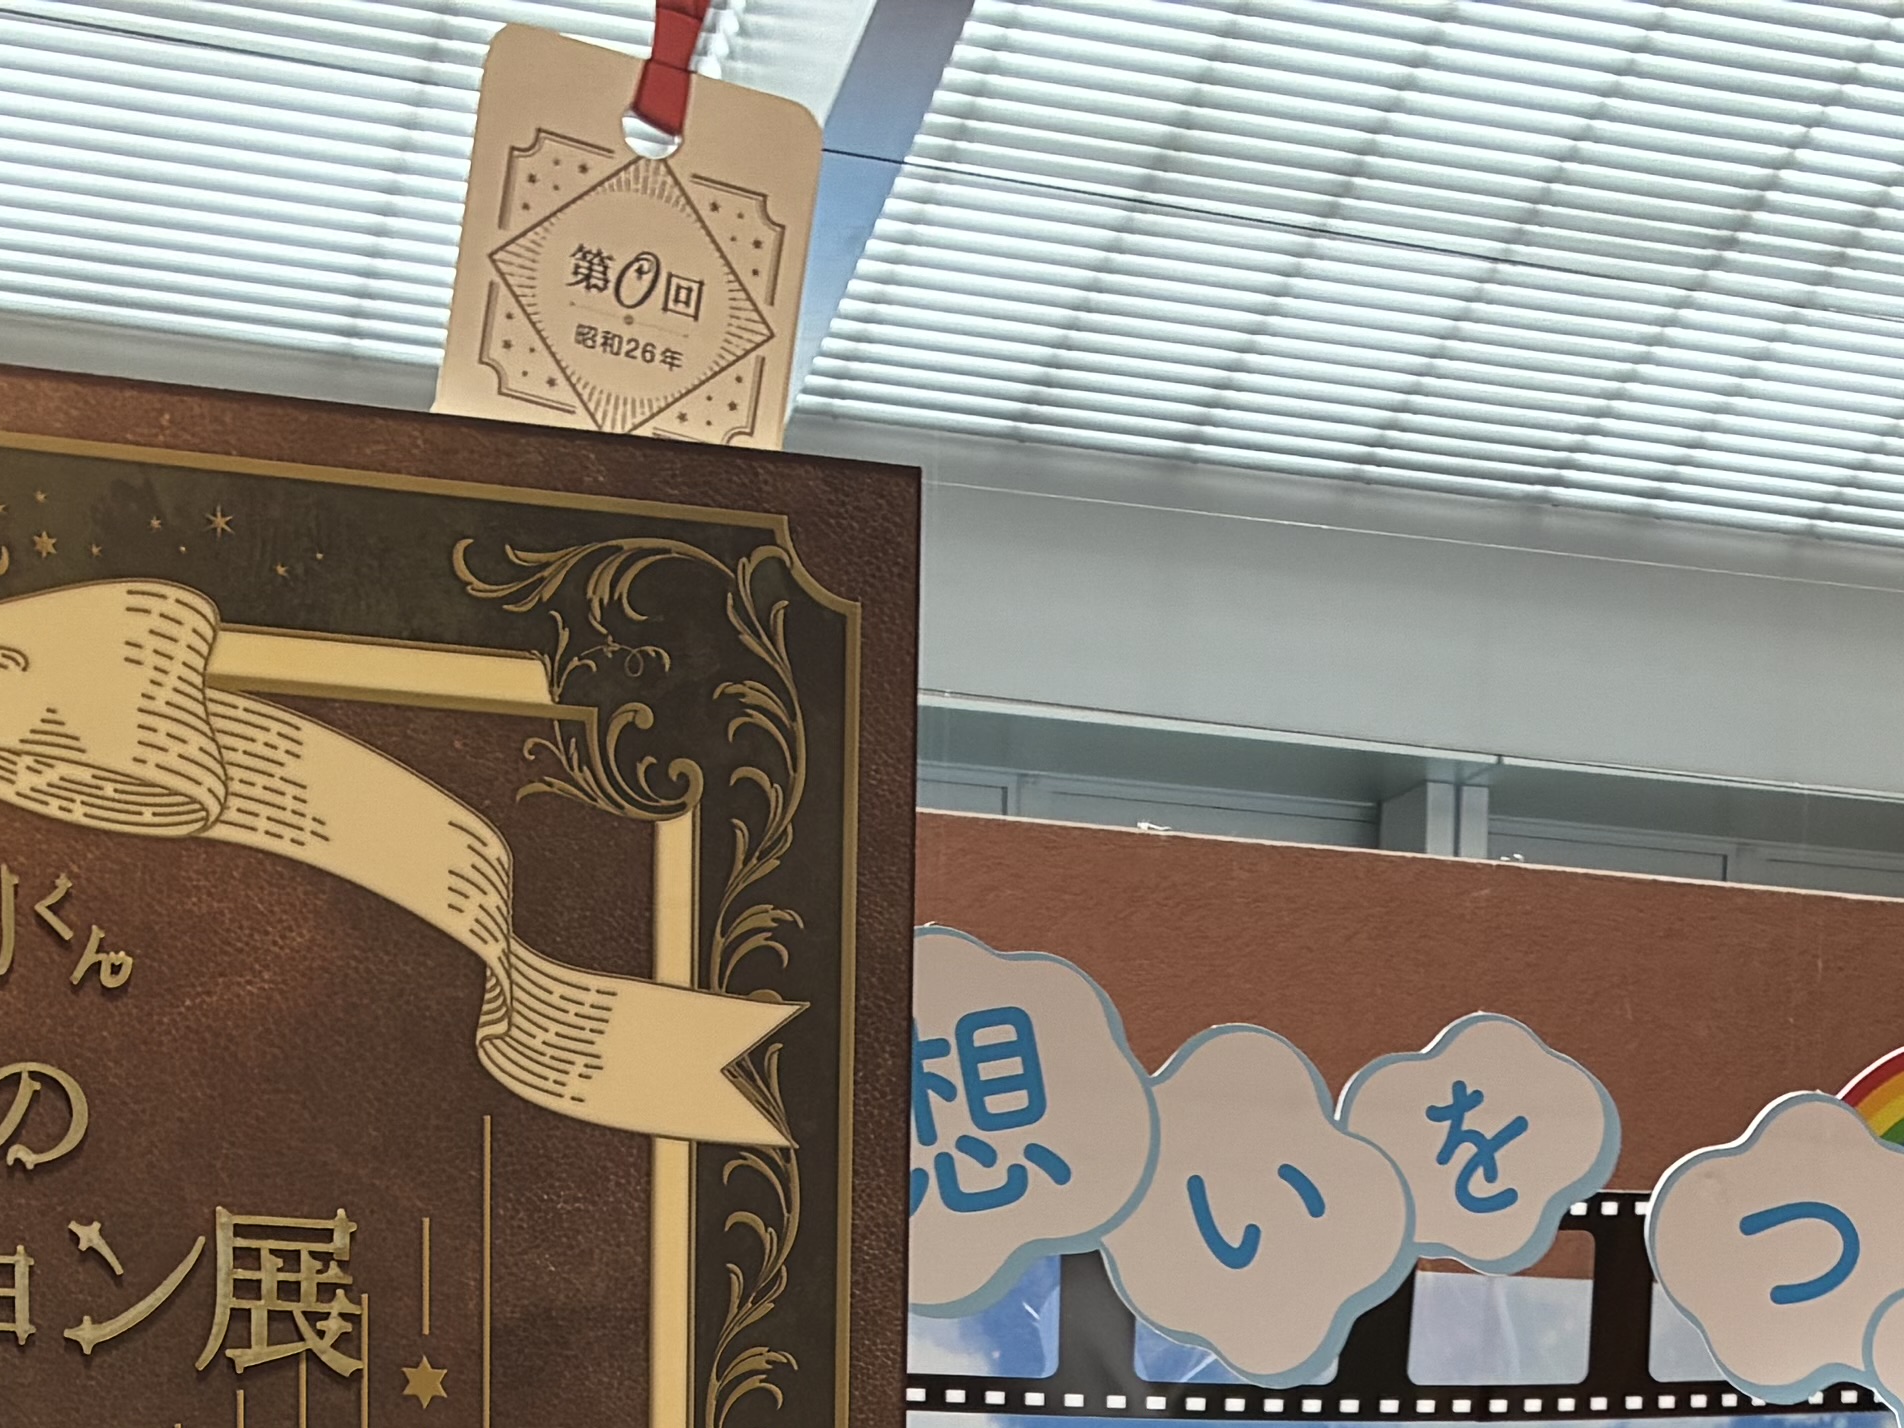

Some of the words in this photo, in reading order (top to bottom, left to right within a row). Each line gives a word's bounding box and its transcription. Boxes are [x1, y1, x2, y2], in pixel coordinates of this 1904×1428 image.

[565, 242, 705, 322] 第0回
[574, 323, 684, 373] 昭和26年
